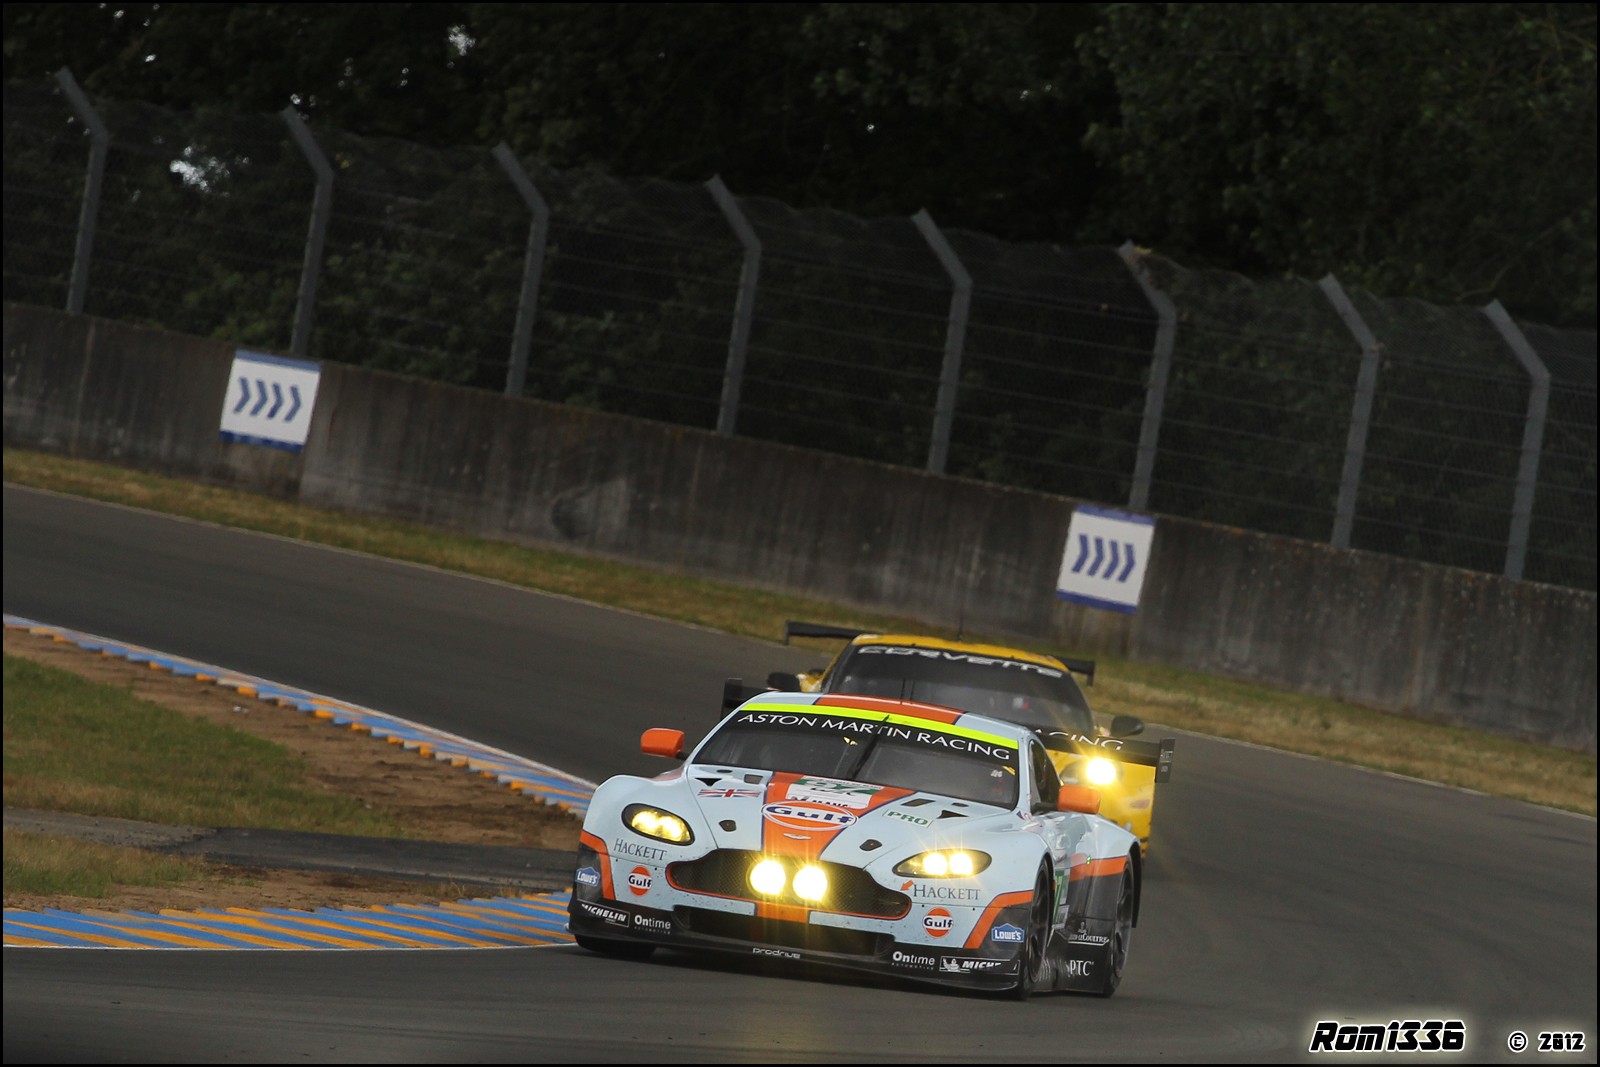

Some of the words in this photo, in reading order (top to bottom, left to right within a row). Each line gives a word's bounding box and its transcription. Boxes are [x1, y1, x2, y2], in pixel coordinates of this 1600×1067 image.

[737, 713, 818, 727] ASTON
[821, 719, 911, 740] MARTIN
[917, 732, 1010, 760] RACING
[765, 806, 853, 824] Gulf
[887, 811, 929, 825] PRO
[613, 838, 668, 860] HACKETT
[577, 870, 598, 885] LOWE'S
[628, 874, 652, 888] Gulf
[912, 884, 981, 900] HACKETT
[634, 914, 671, 929] Ontime
[923, 917, 953, 929] Gulf
[994, 929, 1022, 941] LOWE'S
[752, 947, 801, 959] prodrive
[892, 951, 935, 966] Ontime
[1069, 960, 1090, 976] PTC
